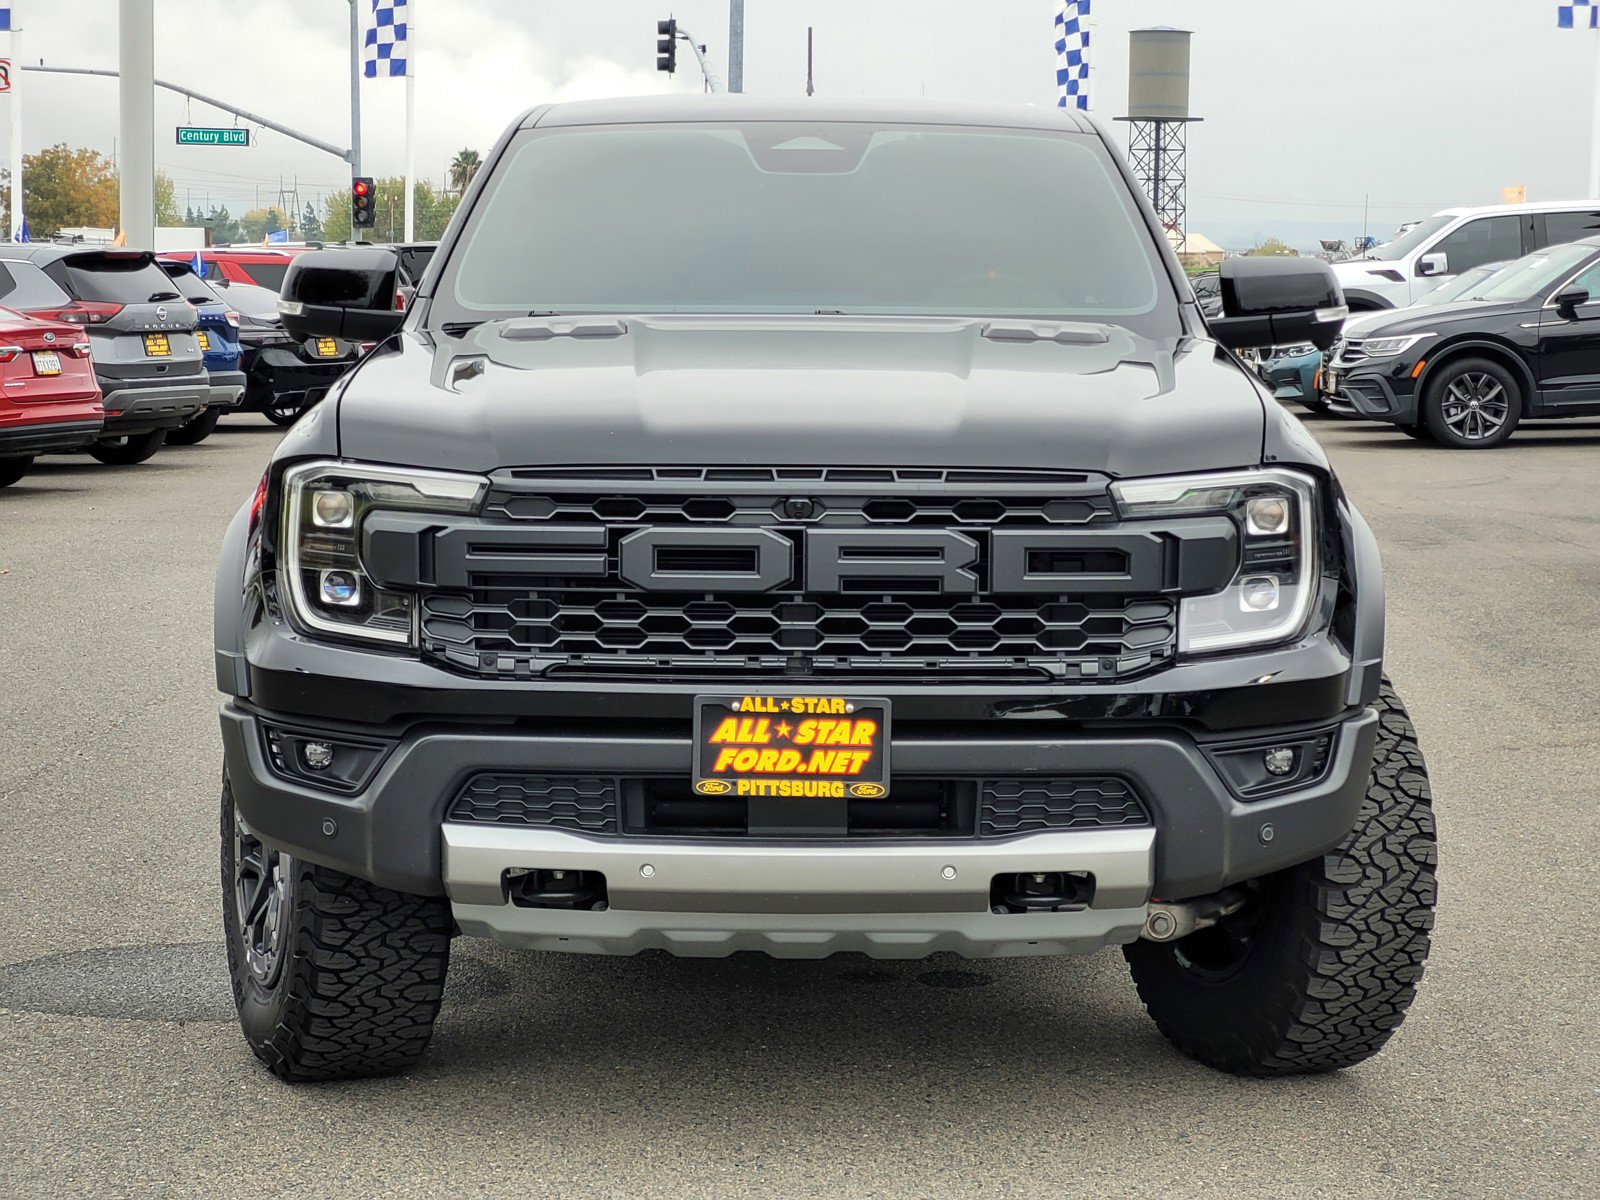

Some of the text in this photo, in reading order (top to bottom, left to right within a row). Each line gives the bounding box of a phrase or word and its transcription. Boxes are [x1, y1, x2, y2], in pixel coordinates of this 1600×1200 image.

[180, 130, 245, 143] Century Blvd
[434, 526, 1163, 594] FORD
[740, 696, 845, 714] ALL STAR
[709, 717, 877, 747] ALL STAR
[713, 747, 872, 775] FORD.NET
[703, 779, 877, 797] Ford PITTSBURG Ford
